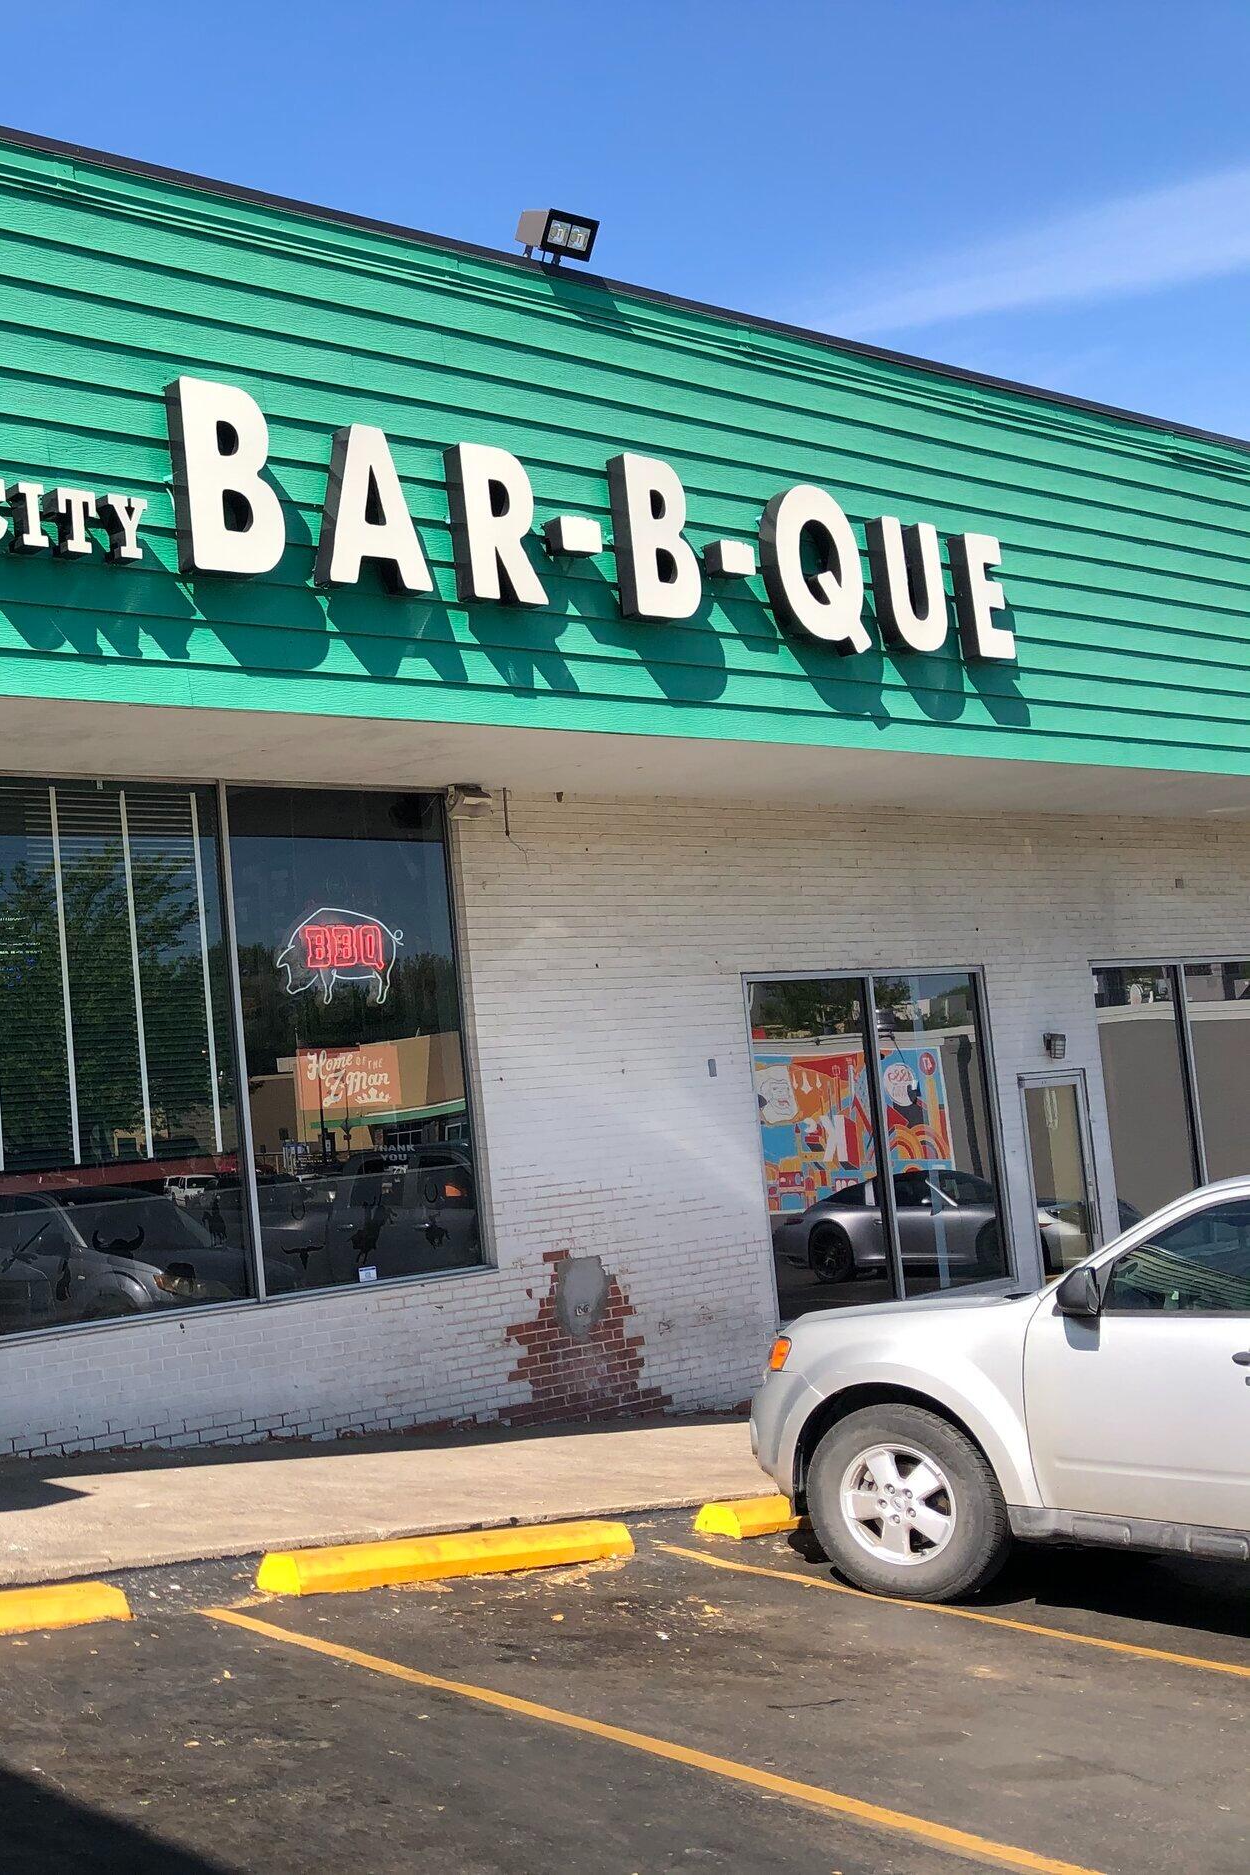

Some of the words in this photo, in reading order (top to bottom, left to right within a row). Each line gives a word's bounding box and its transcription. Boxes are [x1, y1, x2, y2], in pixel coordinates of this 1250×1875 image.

[165, 375, 1016, 660] BAR-B-QUE
[303, 924, 385, 970] BBQ
[306, 1049, 353, 1080] Home
[381, 1153, 408, 1162] YOU
